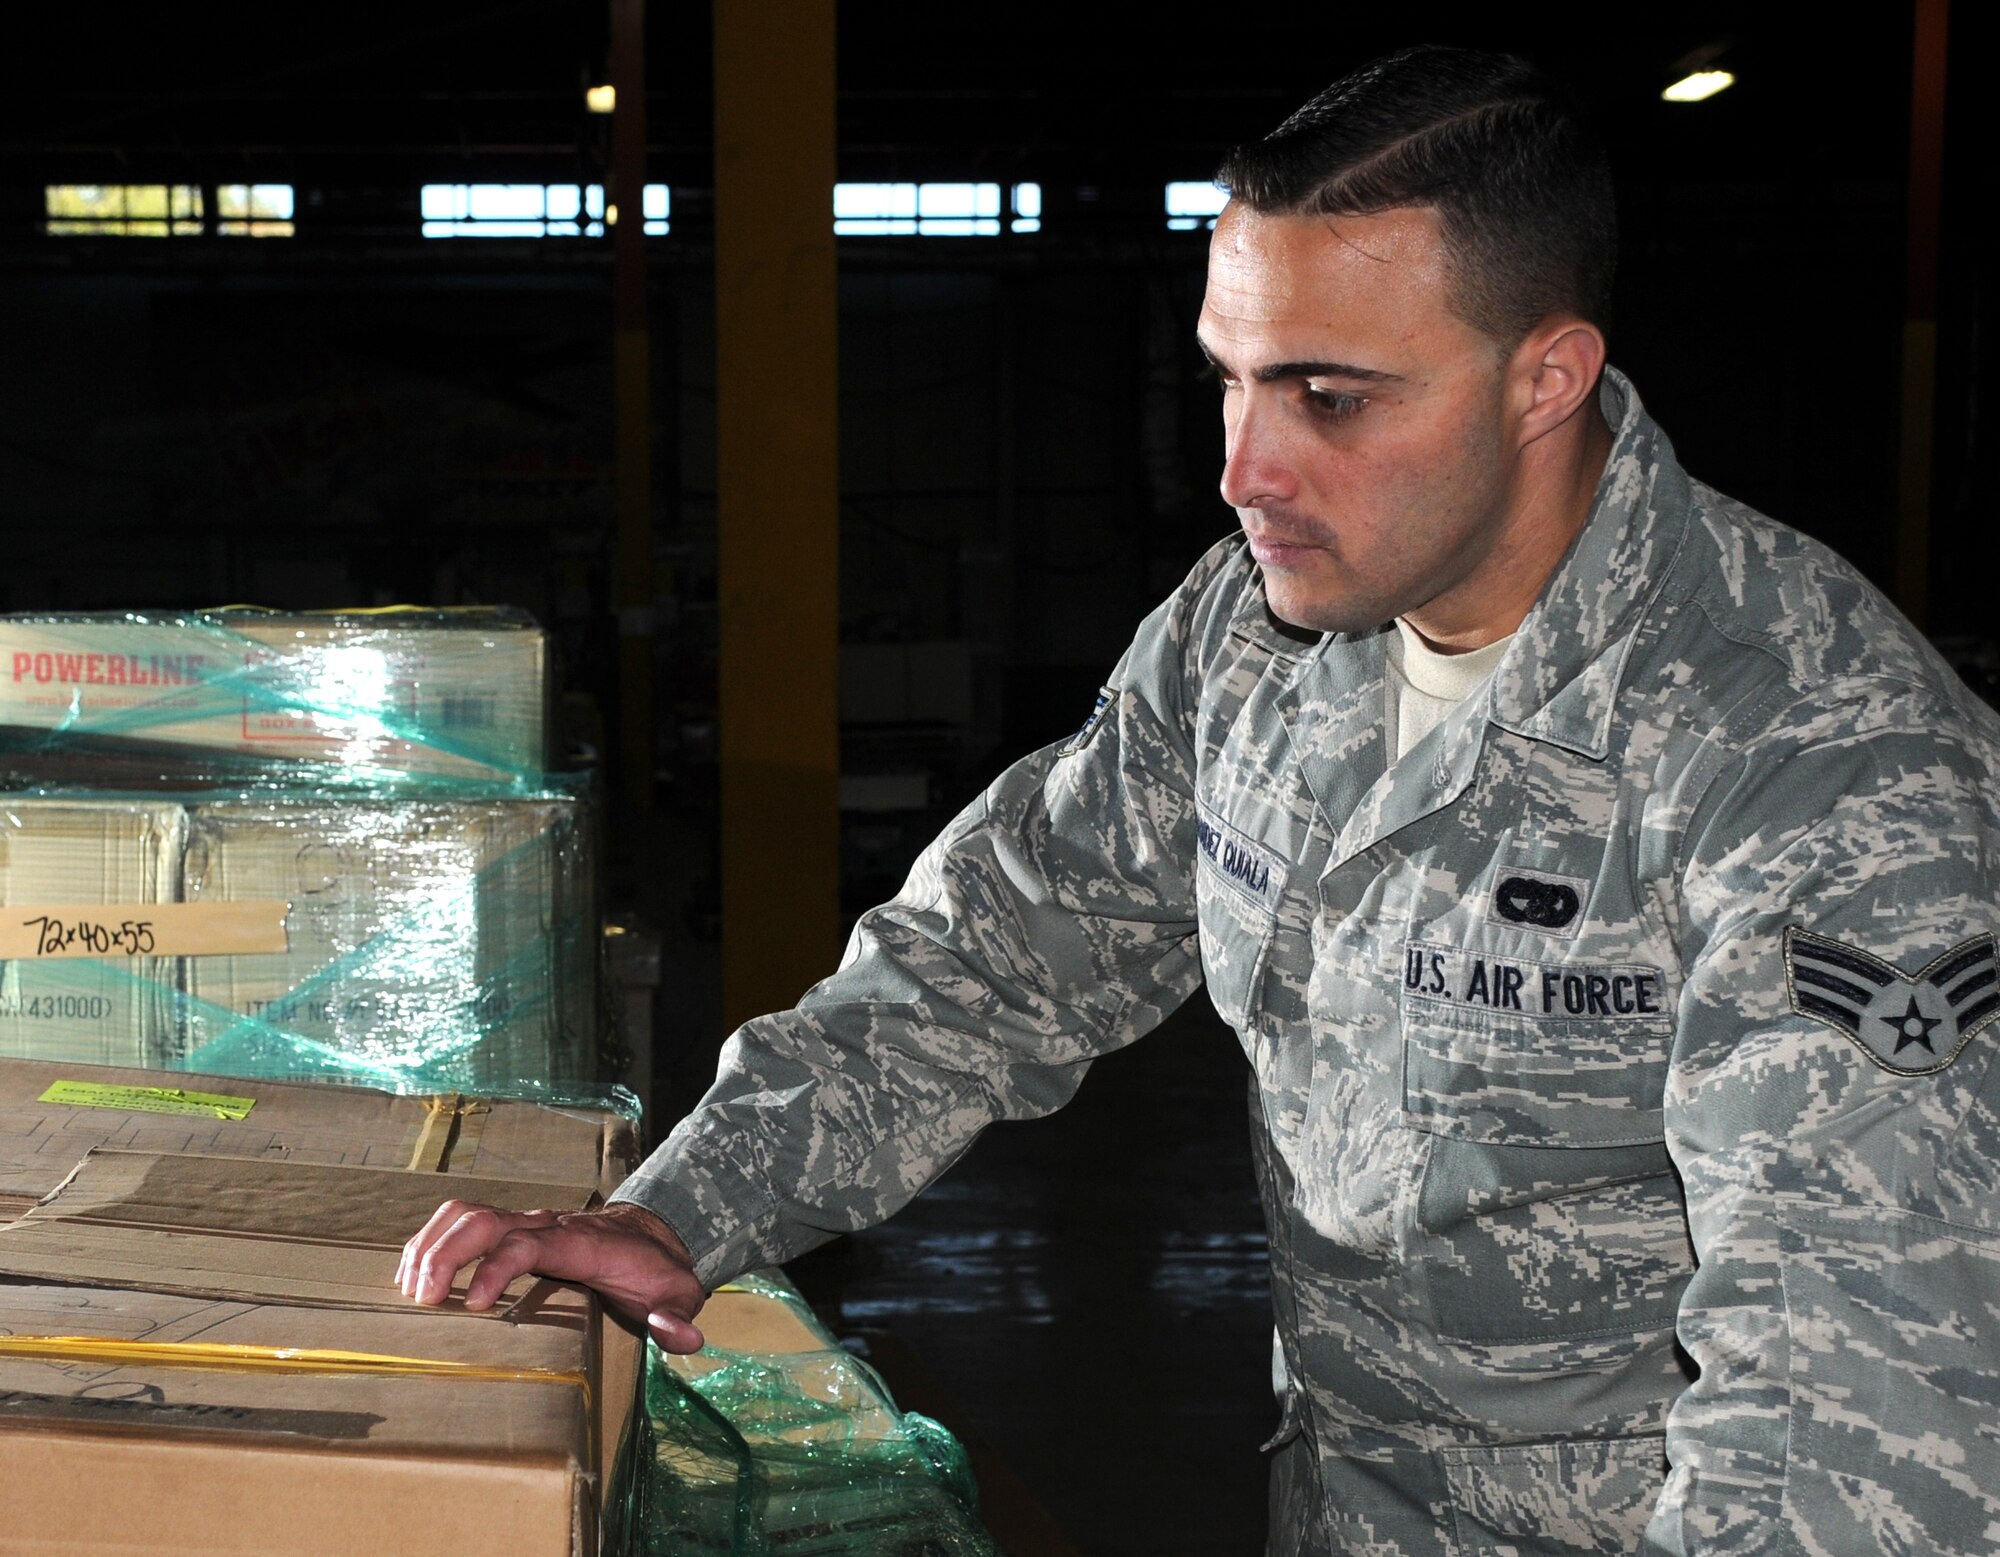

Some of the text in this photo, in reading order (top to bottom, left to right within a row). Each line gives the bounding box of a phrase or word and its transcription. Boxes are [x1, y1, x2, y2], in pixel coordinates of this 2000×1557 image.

[13, 652, 204, 687] POWERLINE
[1223, 841, 1269, 895] QUIALA
[23, 916, 155, 956] 72x40x55
[1405, 948, 1660, 1016] U.S. AIR FORCE
